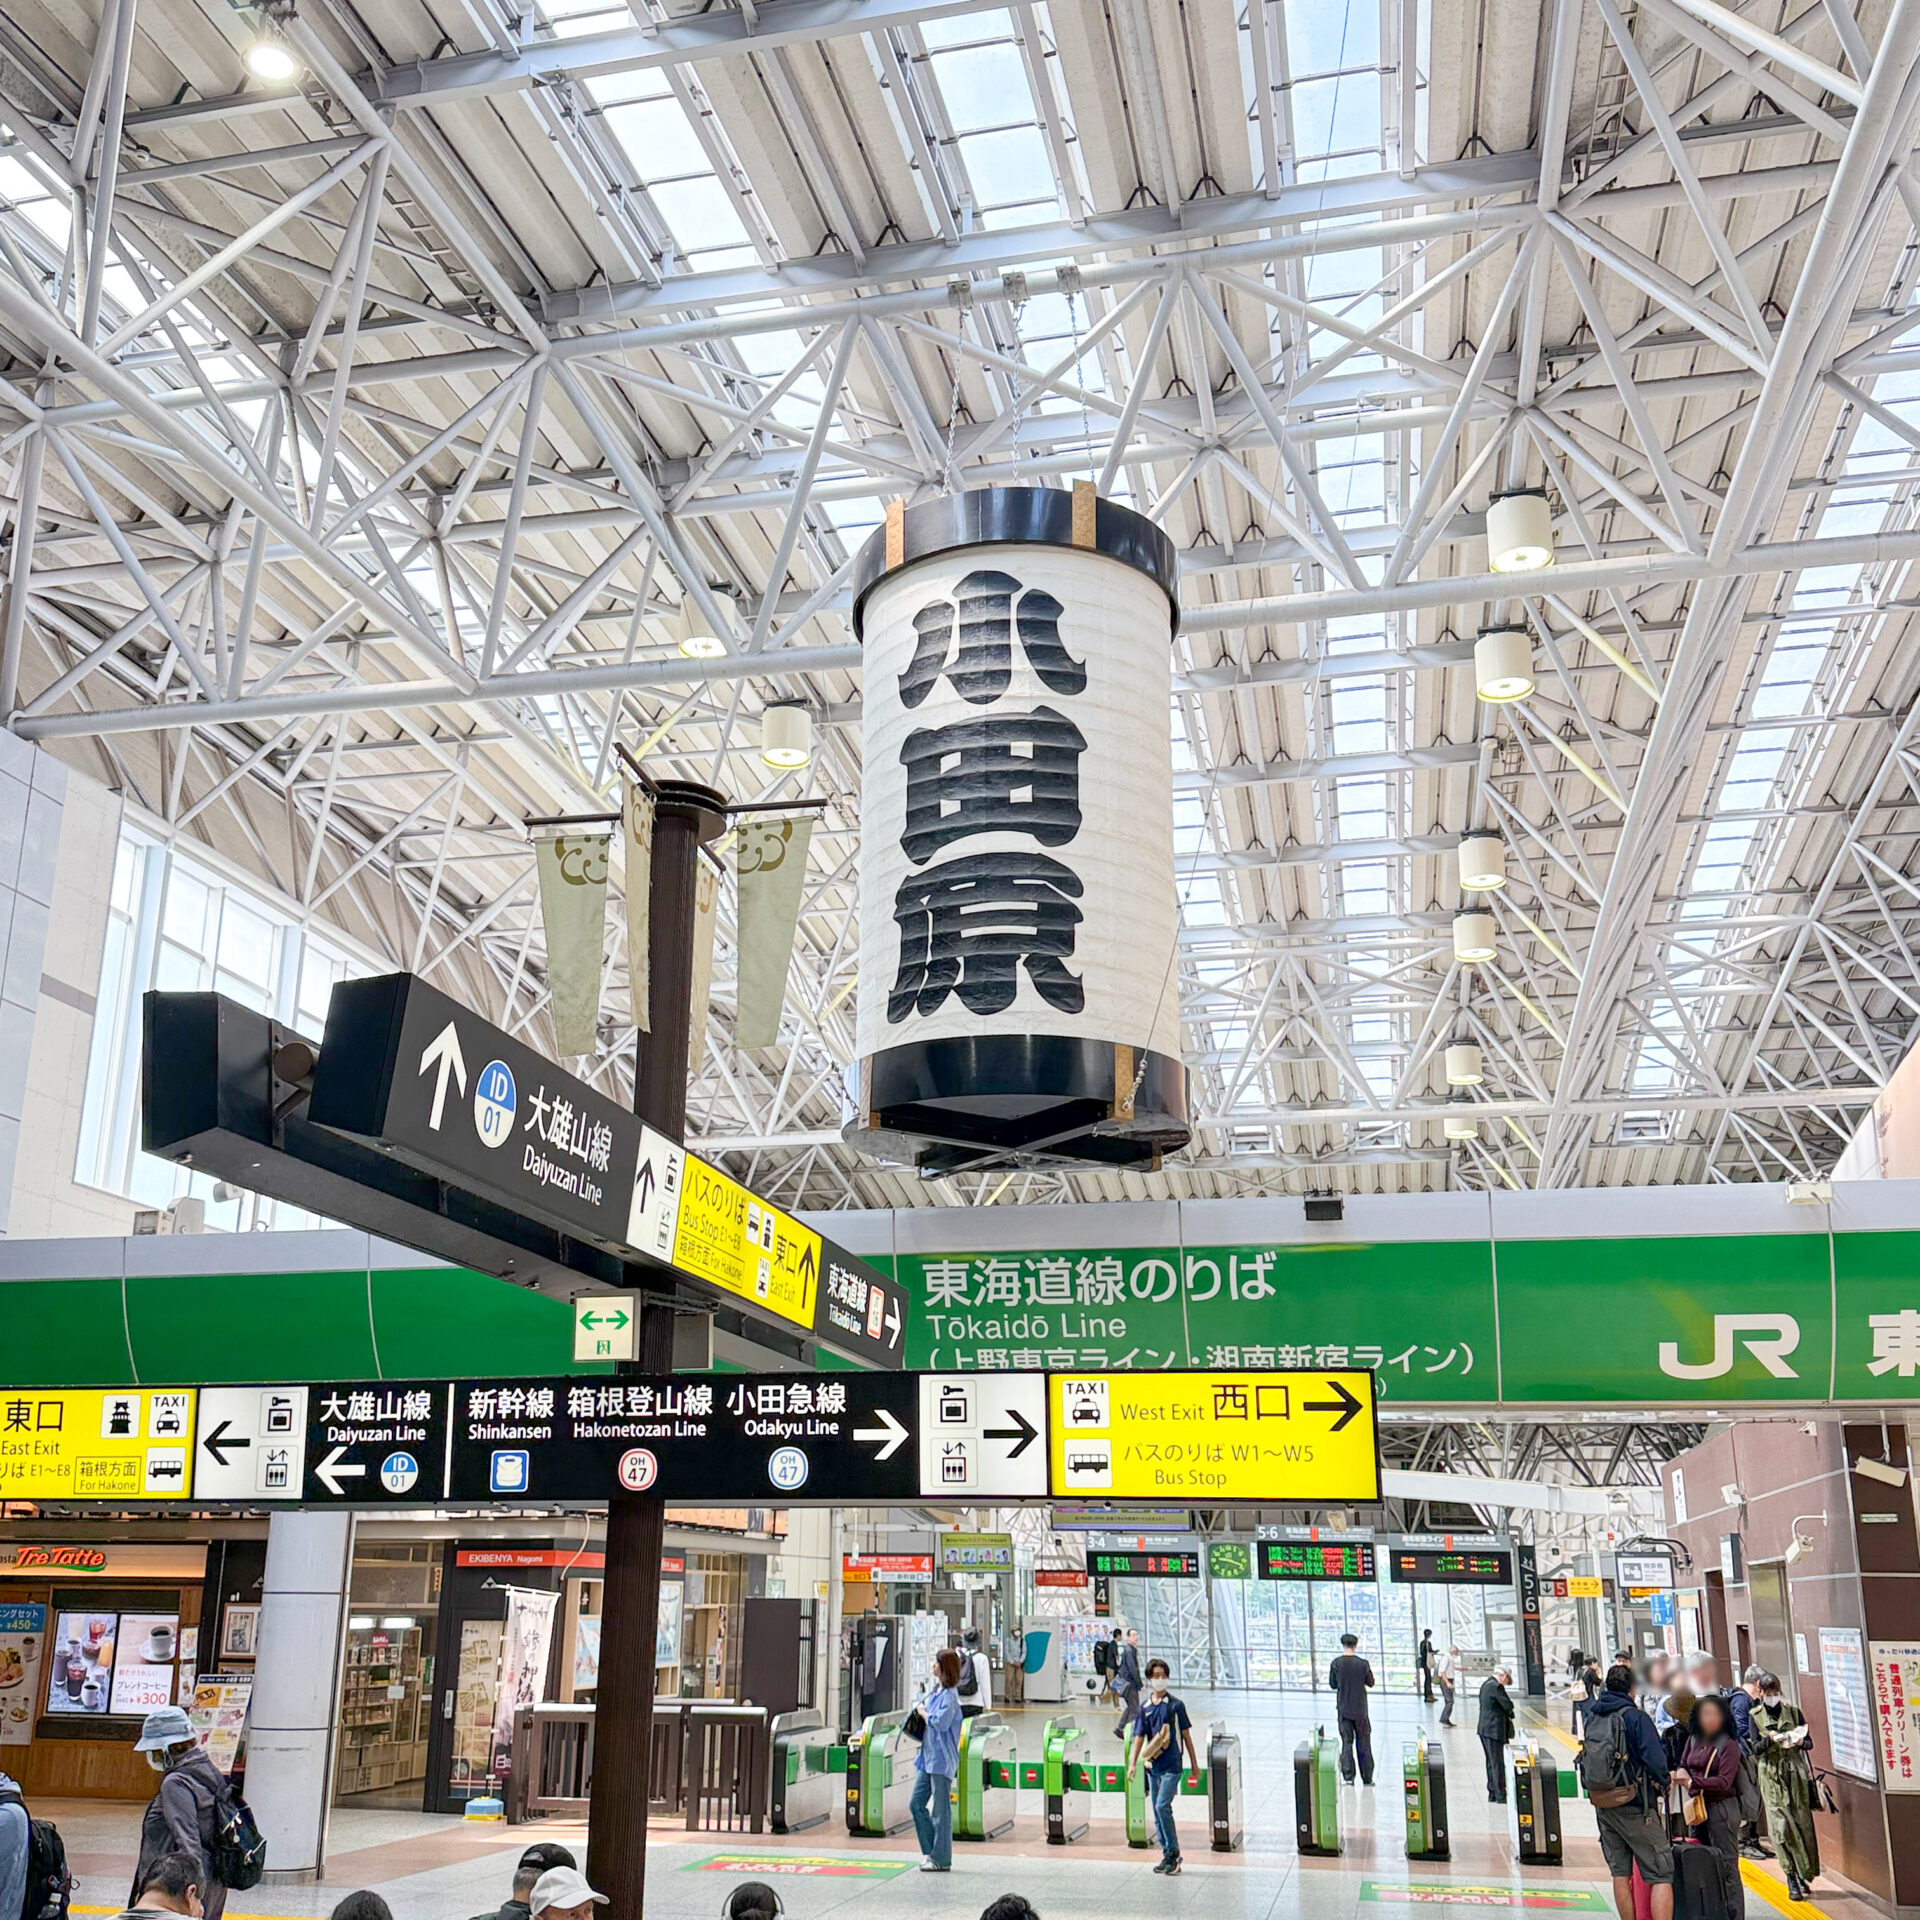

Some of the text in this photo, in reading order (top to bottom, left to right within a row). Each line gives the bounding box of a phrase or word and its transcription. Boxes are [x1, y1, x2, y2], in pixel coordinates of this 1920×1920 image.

[887, 569, 1088, 1025] 小田原
[490, 1069, 509, 1101] ID
[483, 1105, 501, 1137] 01
[523, 1084, 613, 1172] 大雄山線
[522, 1143, 602, 1206] Daiyuzan Line
[685, 1168, 747, 1225] バスのりば
[683, 1204, 699, 1231] Bus
[700, 1213, 719, 1244] Stop
[679, 1233, 711, 1266] 箱根方面
[774, 1234, 798, 1277] 東口
[826, 1262, 868, 1313] 東海道線
[922, 1250, 1278, 1308] 東海道線のりば
[925, 1312, 1127, 1341] Tōkaidō Line
[1658, 1308, 1920, 1381] JR 東
[1066, 1382, 1105, 1395] TAXI
[153, 1395, 186, 1408] TAXI
[319, 1389, 432, 1423] 大雄山線
[467, 1382, 847, 1420] 新幹線 箱根登山線 小田急線
[1120, 1402, 1205, 1422] West Exit
[1210, 1383, 1292, 1422] 西口
[3, 1397, 64, 1433] 東口
[327, 1426, 427, 1444] Daiyuzan Line
[468, 1422, 553, 1441] Shinkansen
[573, 1420, 707, 1439] Hakonetozan Line
[743, 1418, 840, 1440] Odakyu Line
[1, 1439, 60, 1456] East Exit
[1123, 1441, 1224, 1463] バスのりば
[80, 1461, 137, 1477] 箱根方面
[391, 1456, 408, 1472] ID
[629, 1456, 646, 1467] OH
[779, 1454, 797, 1465] OH
[391, 1473, 406, 1488] 01
[627, 1466, 648, 1483] 47
[777, 1465, 798, 1482] 47
[1154, 1468, 1227, 1489] Bus Stop
[80, 1480, 136, 1491] For Hakone
[16, 1545, 106, 1567] Tre Tatte
[468, 1554, 543, 1564] EKIBENYA Nagomi
[920, 1557, 931, 1572] 4
[1074, 1574, 1085, 1585] 4
[1556, 1582, 1567, 1596] 5
[1666, 1626, 1676, 1656] AED
[1875, 1662, 1897, 1771] こちらで購入できます
[1403, 1755, 1418, 1766] IC
